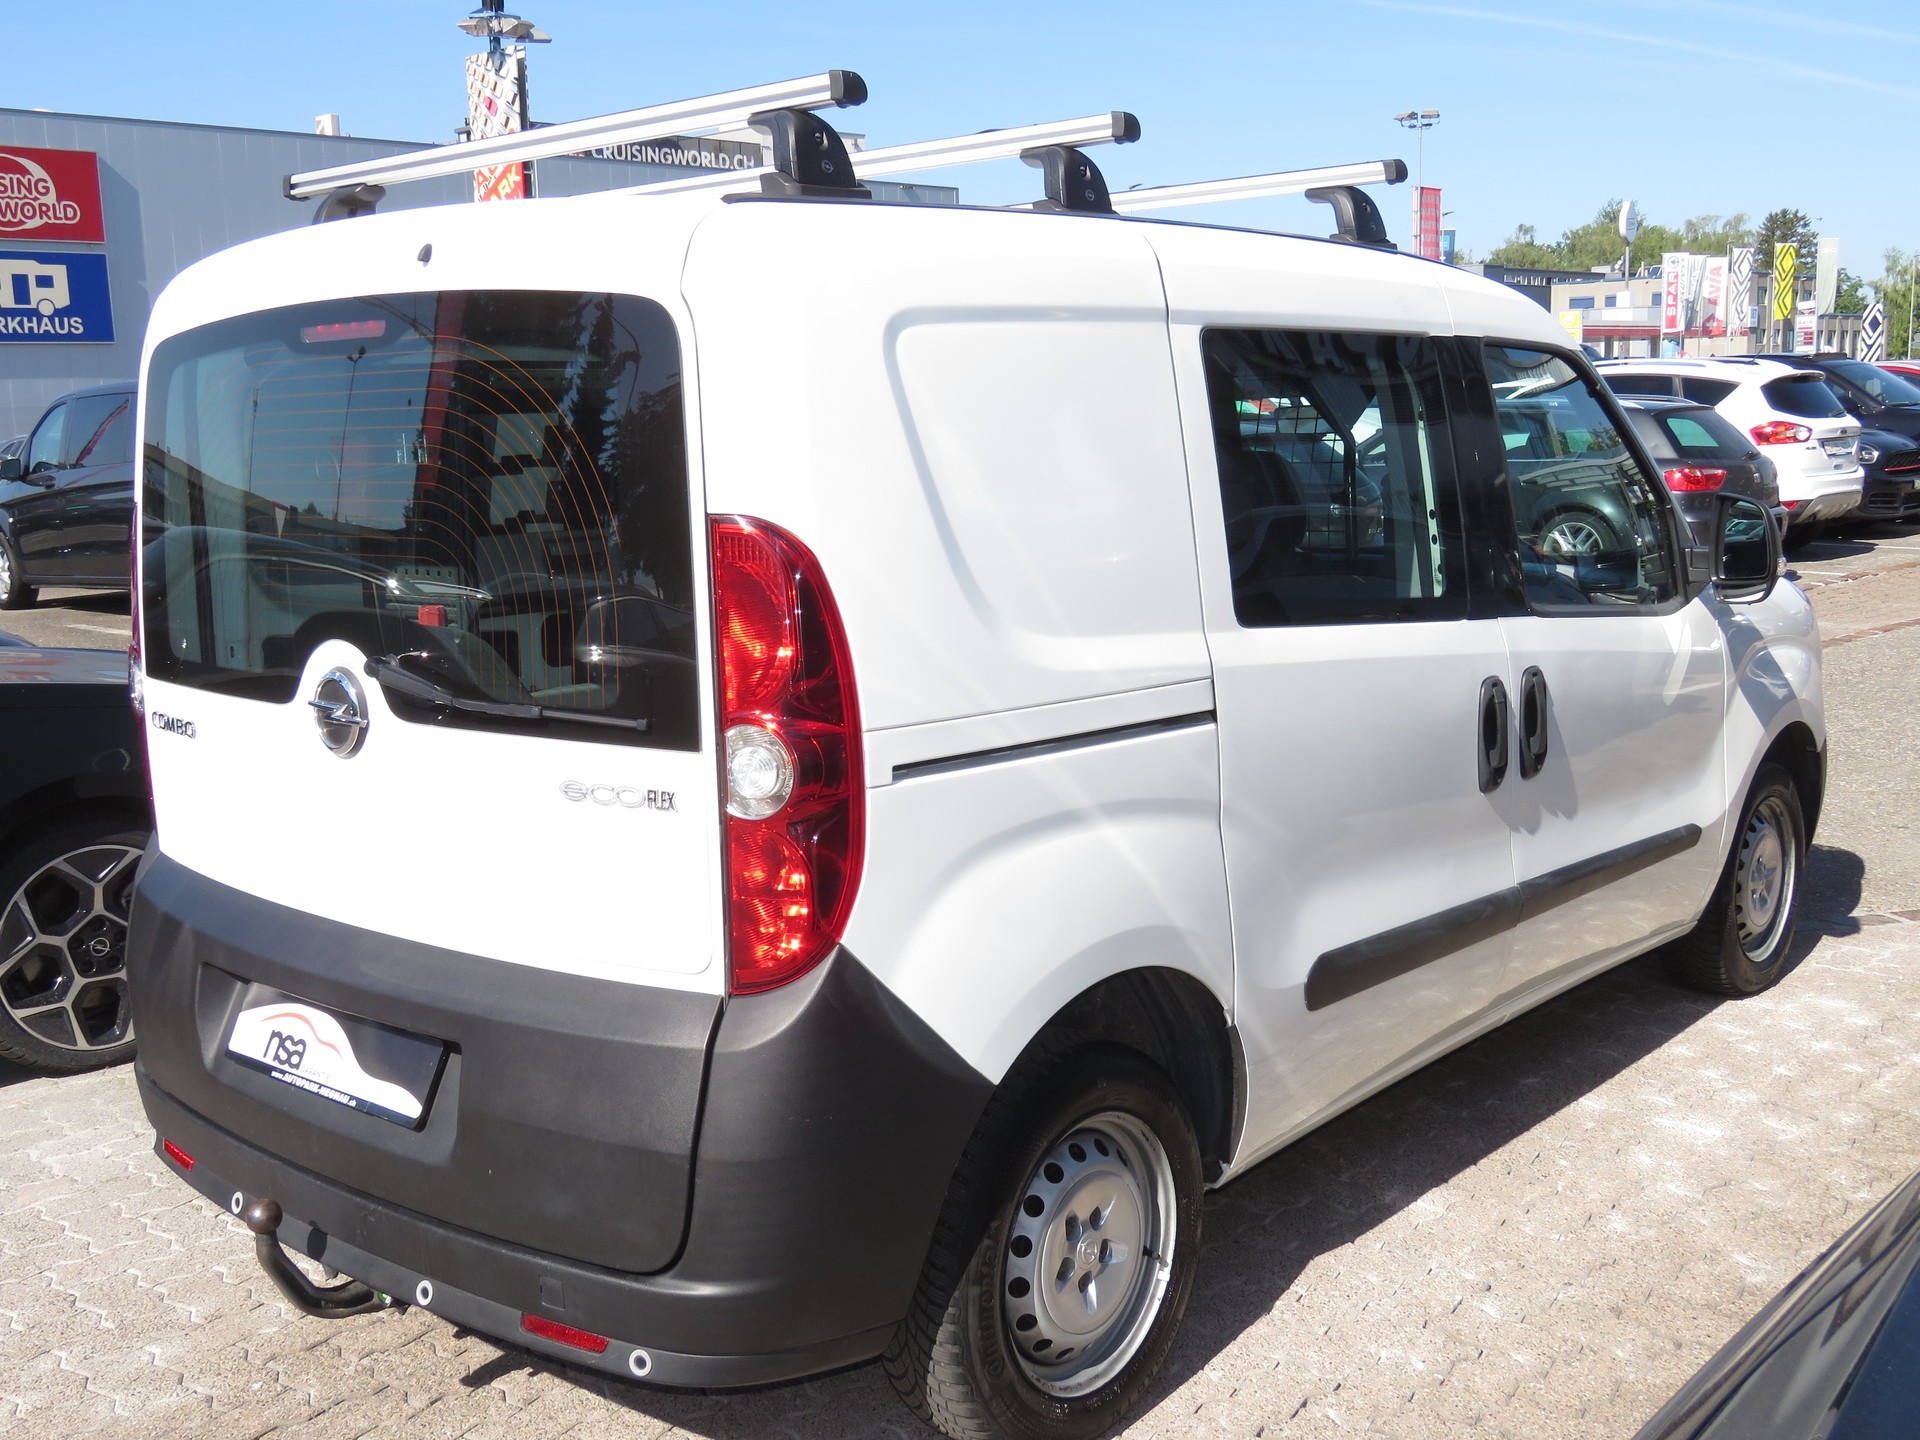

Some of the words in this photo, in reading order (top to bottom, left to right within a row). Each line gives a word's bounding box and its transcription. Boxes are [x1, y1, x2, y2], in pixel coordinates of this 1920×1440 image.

[1667, 272, 1677, 316] SPAR
[1707, 265, 1722, 306] AVIA
[152, 710, 196, 739] COMBO
[263, 1029, 307, 1070] nsa
